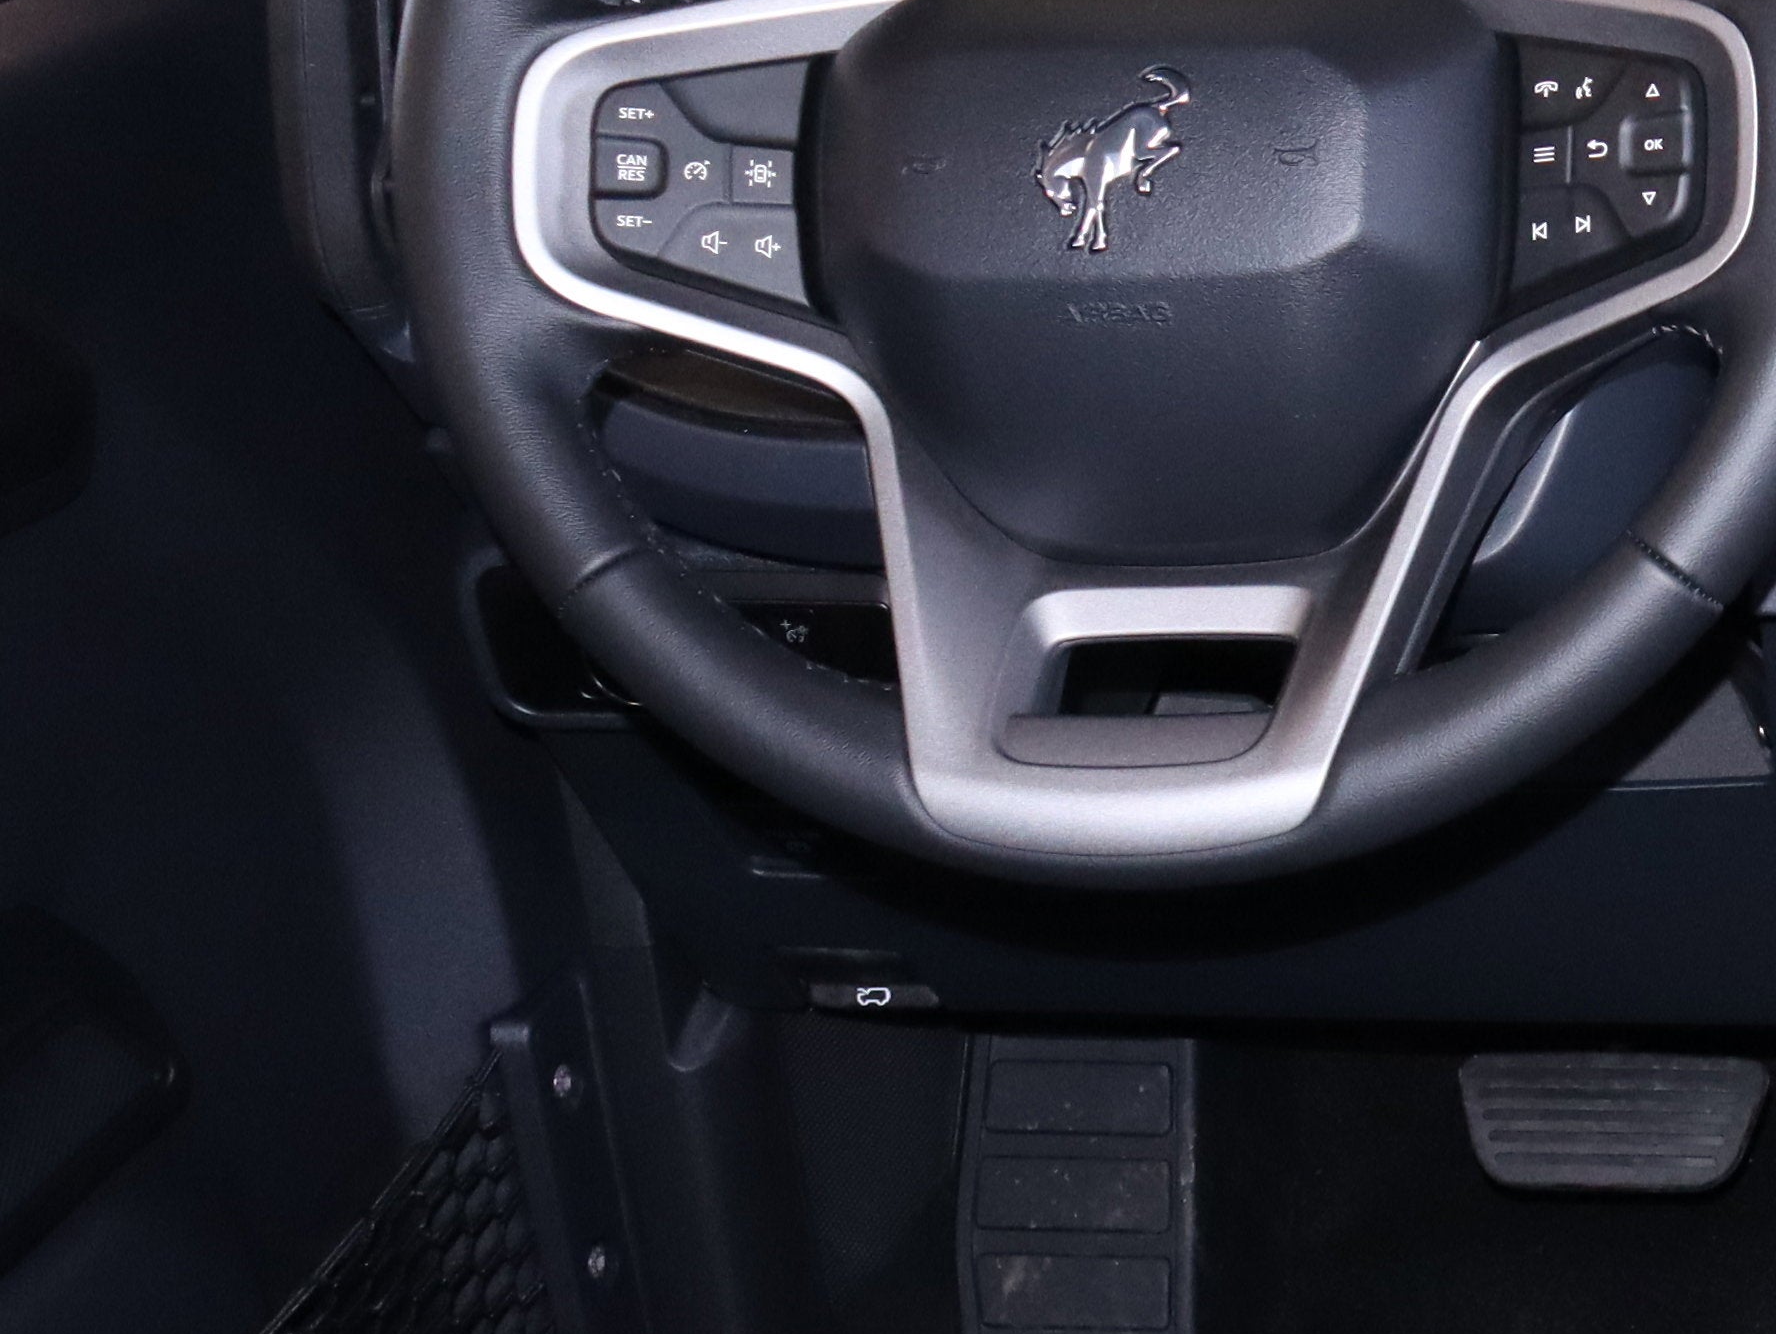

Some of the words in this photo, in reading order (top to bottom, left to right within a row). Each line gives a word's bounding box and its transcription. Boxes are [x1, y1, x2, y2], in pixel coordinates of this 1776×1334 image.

[618, 107, 654, 120] SET+
[1644, 138, 1664, 151] OK
[616, 154, 647, 167] CAN
[617, 169, 645, 181] RES
